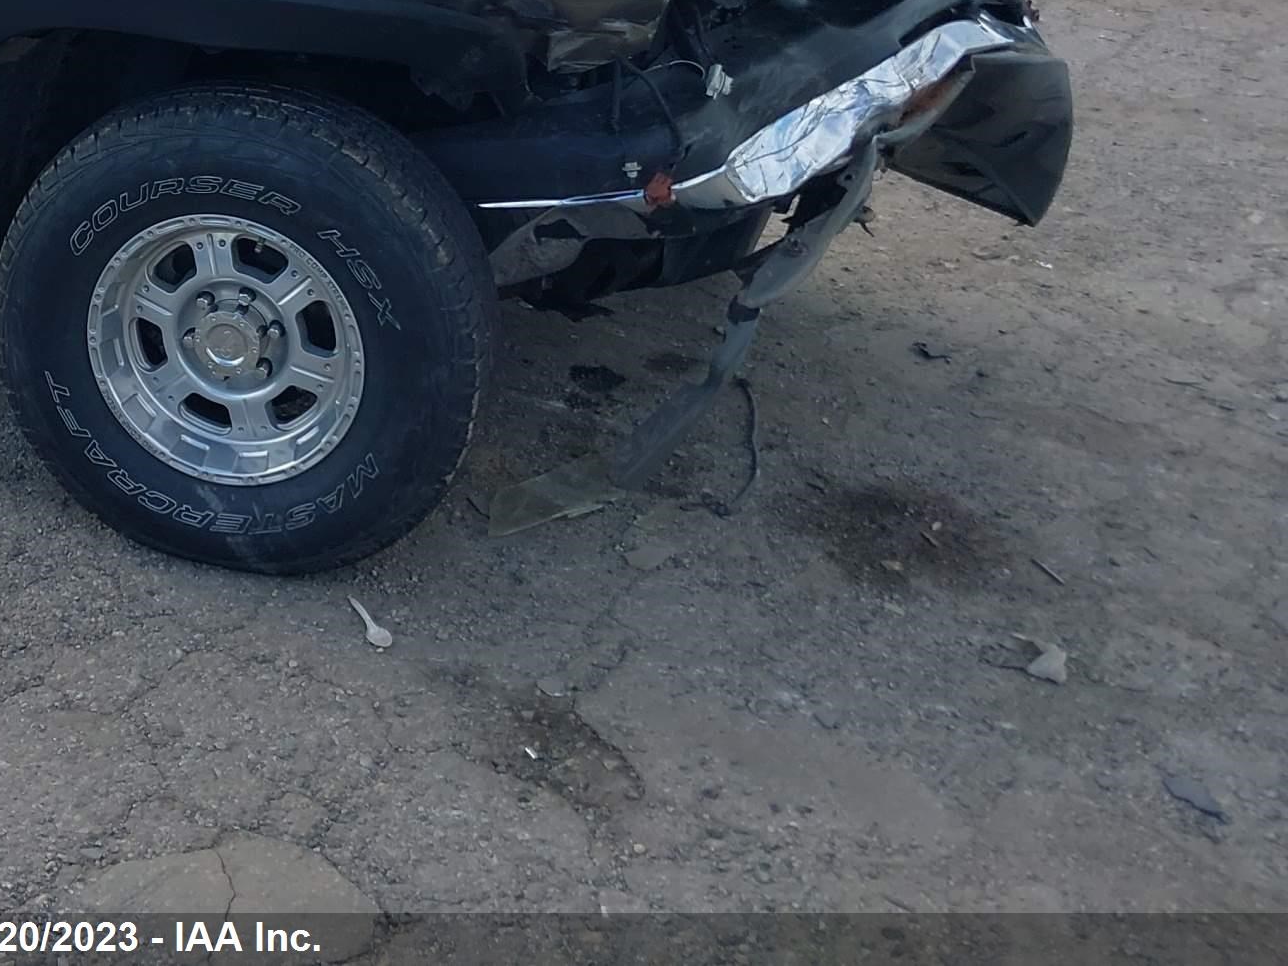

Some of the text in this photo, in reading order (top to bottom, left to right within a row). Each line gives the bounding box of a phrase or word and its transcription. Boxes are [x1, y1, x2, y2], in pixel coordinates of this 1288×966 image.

[69, 175, 402, 331] COURSER HSX
[44, 370, 381, 535] MASTERCRAFT
